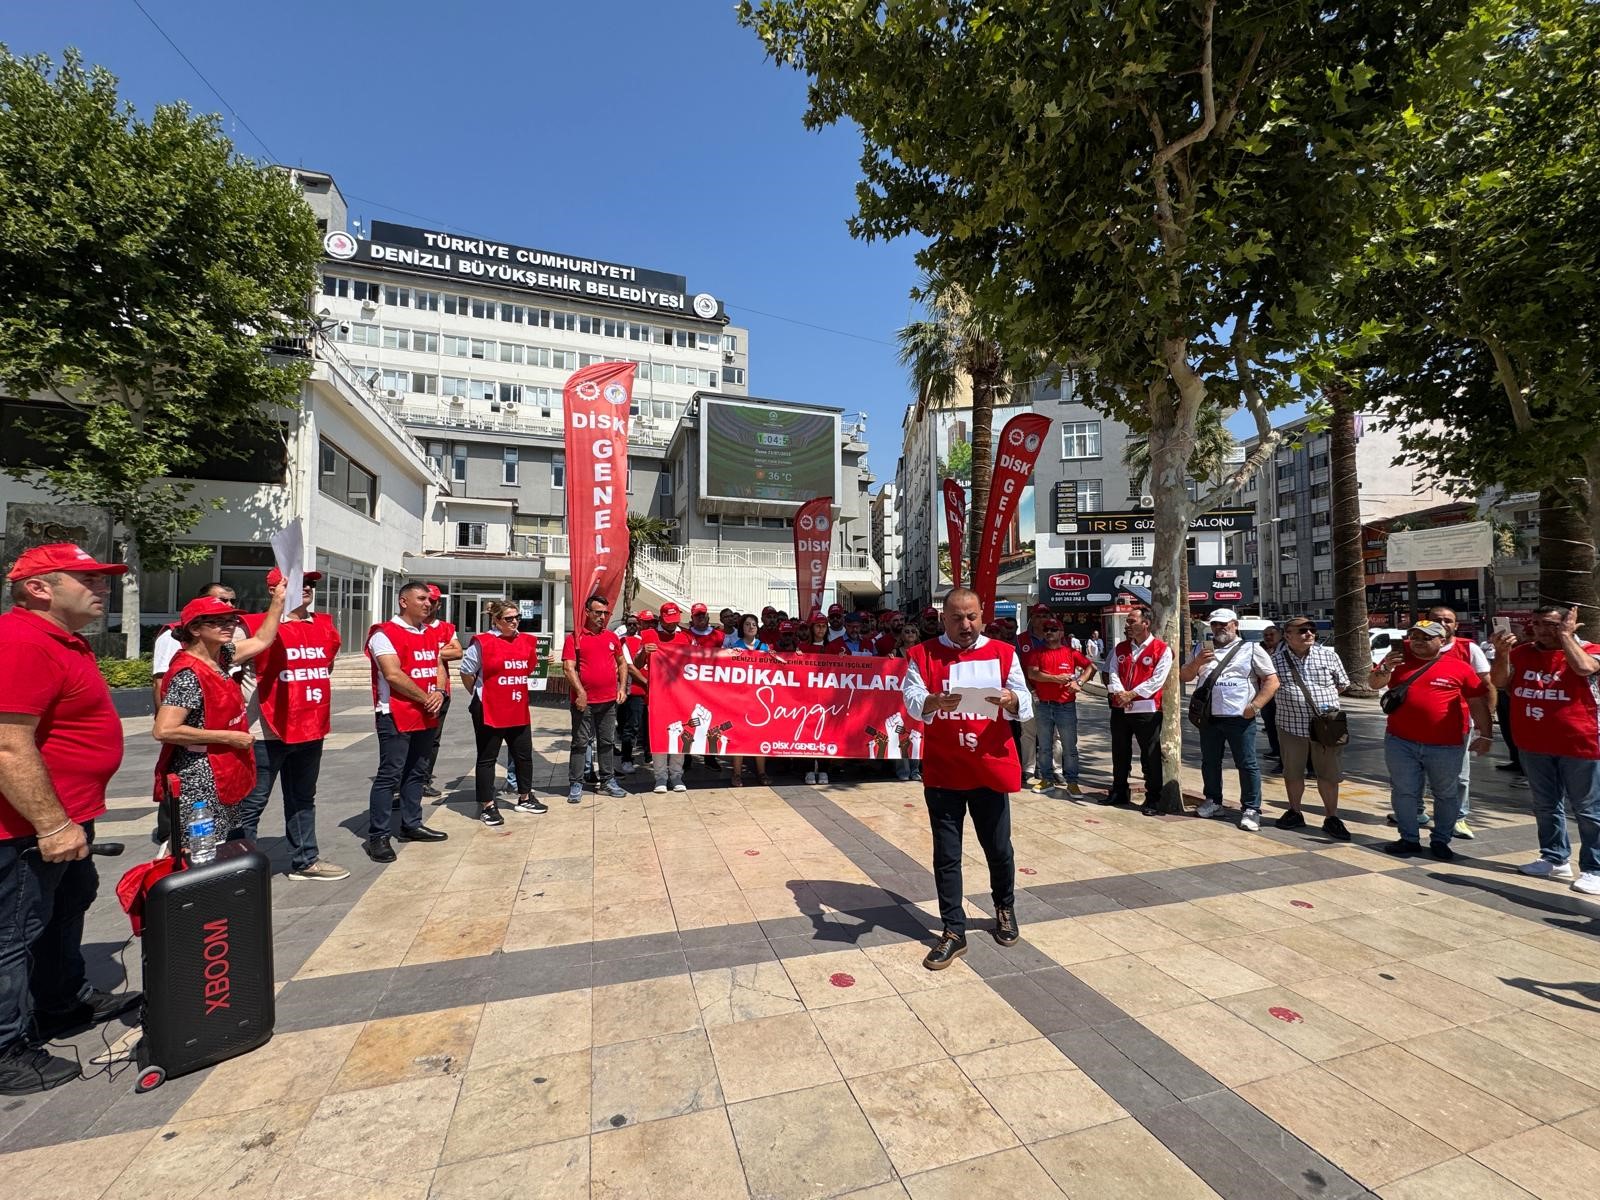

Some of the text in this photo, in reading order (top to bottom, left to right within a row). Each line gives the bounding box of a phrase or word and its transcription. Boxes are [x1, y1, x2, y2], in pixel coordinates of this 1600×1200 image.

[424, 233, 636, 281] TÜRKİYE CUMHURİYETİ
[370, 244, 685, 309] DENİZLİ BÜYÜKŞEHİR BELEDİYESİ
[572, 410, 626, 437] DİSK
[1000, 454, 1031, 475] DİSK
[768, 471, 780, 481] 36
[591, 439, 614, 555] GENEL
[1088, 520, 1128, 531] IRIS
[1134, 519, 1155, 530] GÜZ
[798, 538, 830, 552] DİSK
[1053, 576, 1086, 587] Torku
[286, 644, 327, 660] DİSK
[504, 658, 529, 670] DİSK
[683, 663, 801, 687] SENDİKAL
[306, 685, 323, 704] İŞ
[512, 689, 523, 703] İŞ
[1525, 703, 1545, 721] İŞ
[958, 728, 979, 753] İŞ
[203, 918, 231, 1016] XBOOM
